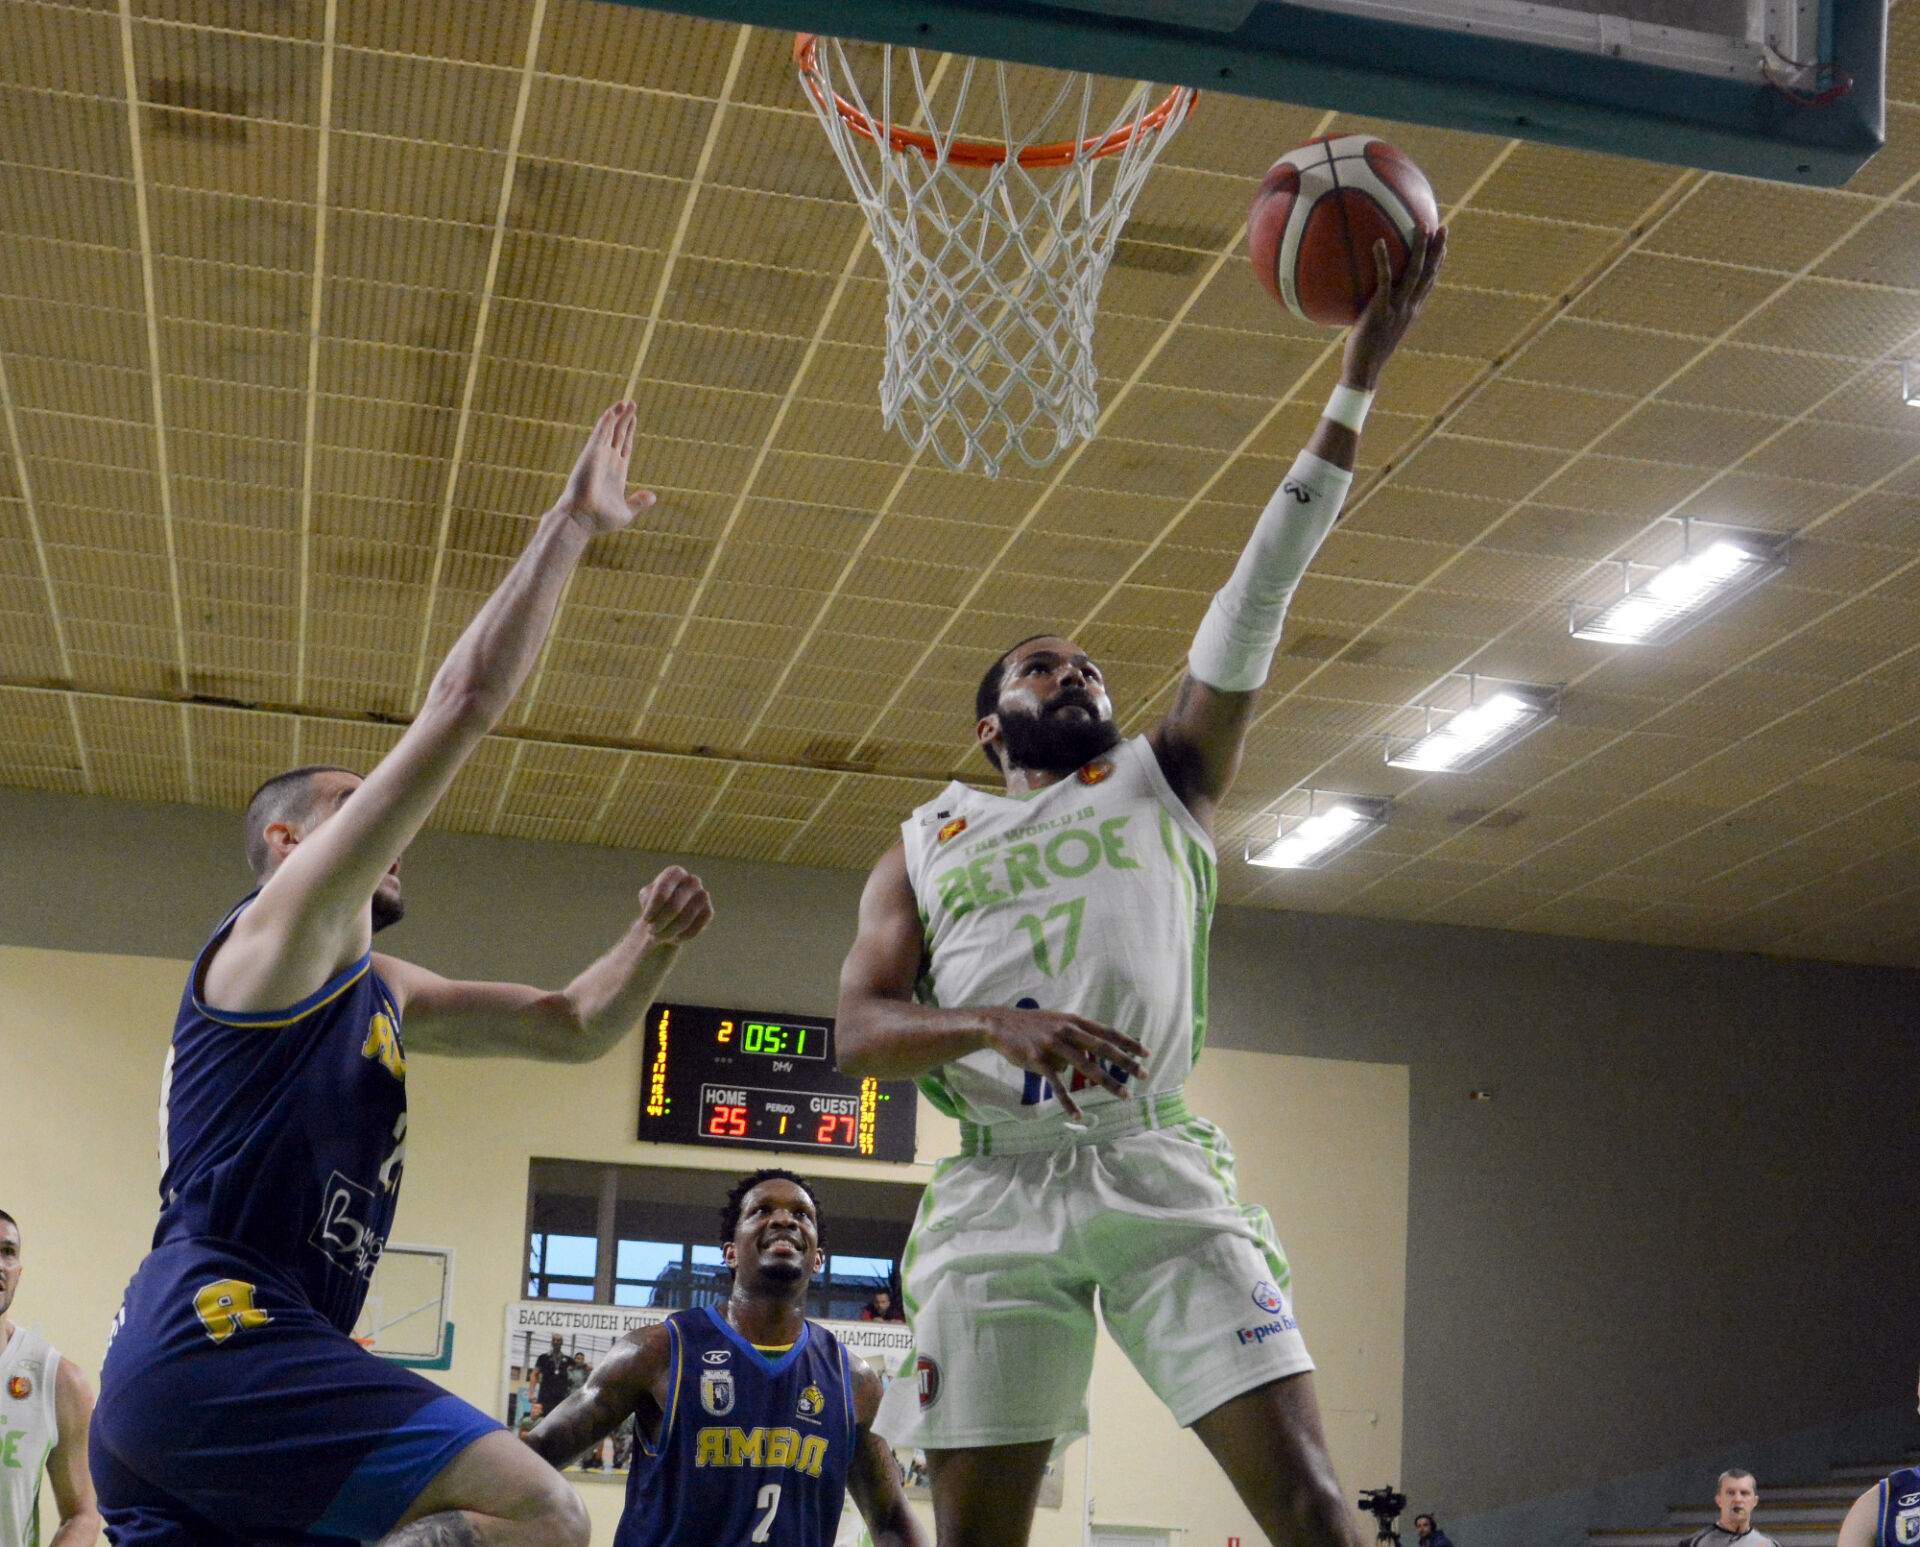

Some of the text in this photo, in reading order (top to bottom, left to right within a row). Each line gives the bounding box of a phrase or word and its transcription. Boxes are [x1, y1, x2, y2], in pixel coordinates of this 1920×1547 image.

[1014, 896, 1087, 978] 17
[717, 1021, 733, 1042] 2
[705, 1089, 856, 1116] HOME PERIOD GUEST
[709, 1106, 856, 1144] 25 1 27
[518, 1309, 618, 1330] БАСКЕТБОЛЕН
[752, 1483, 782, 1543] 2
